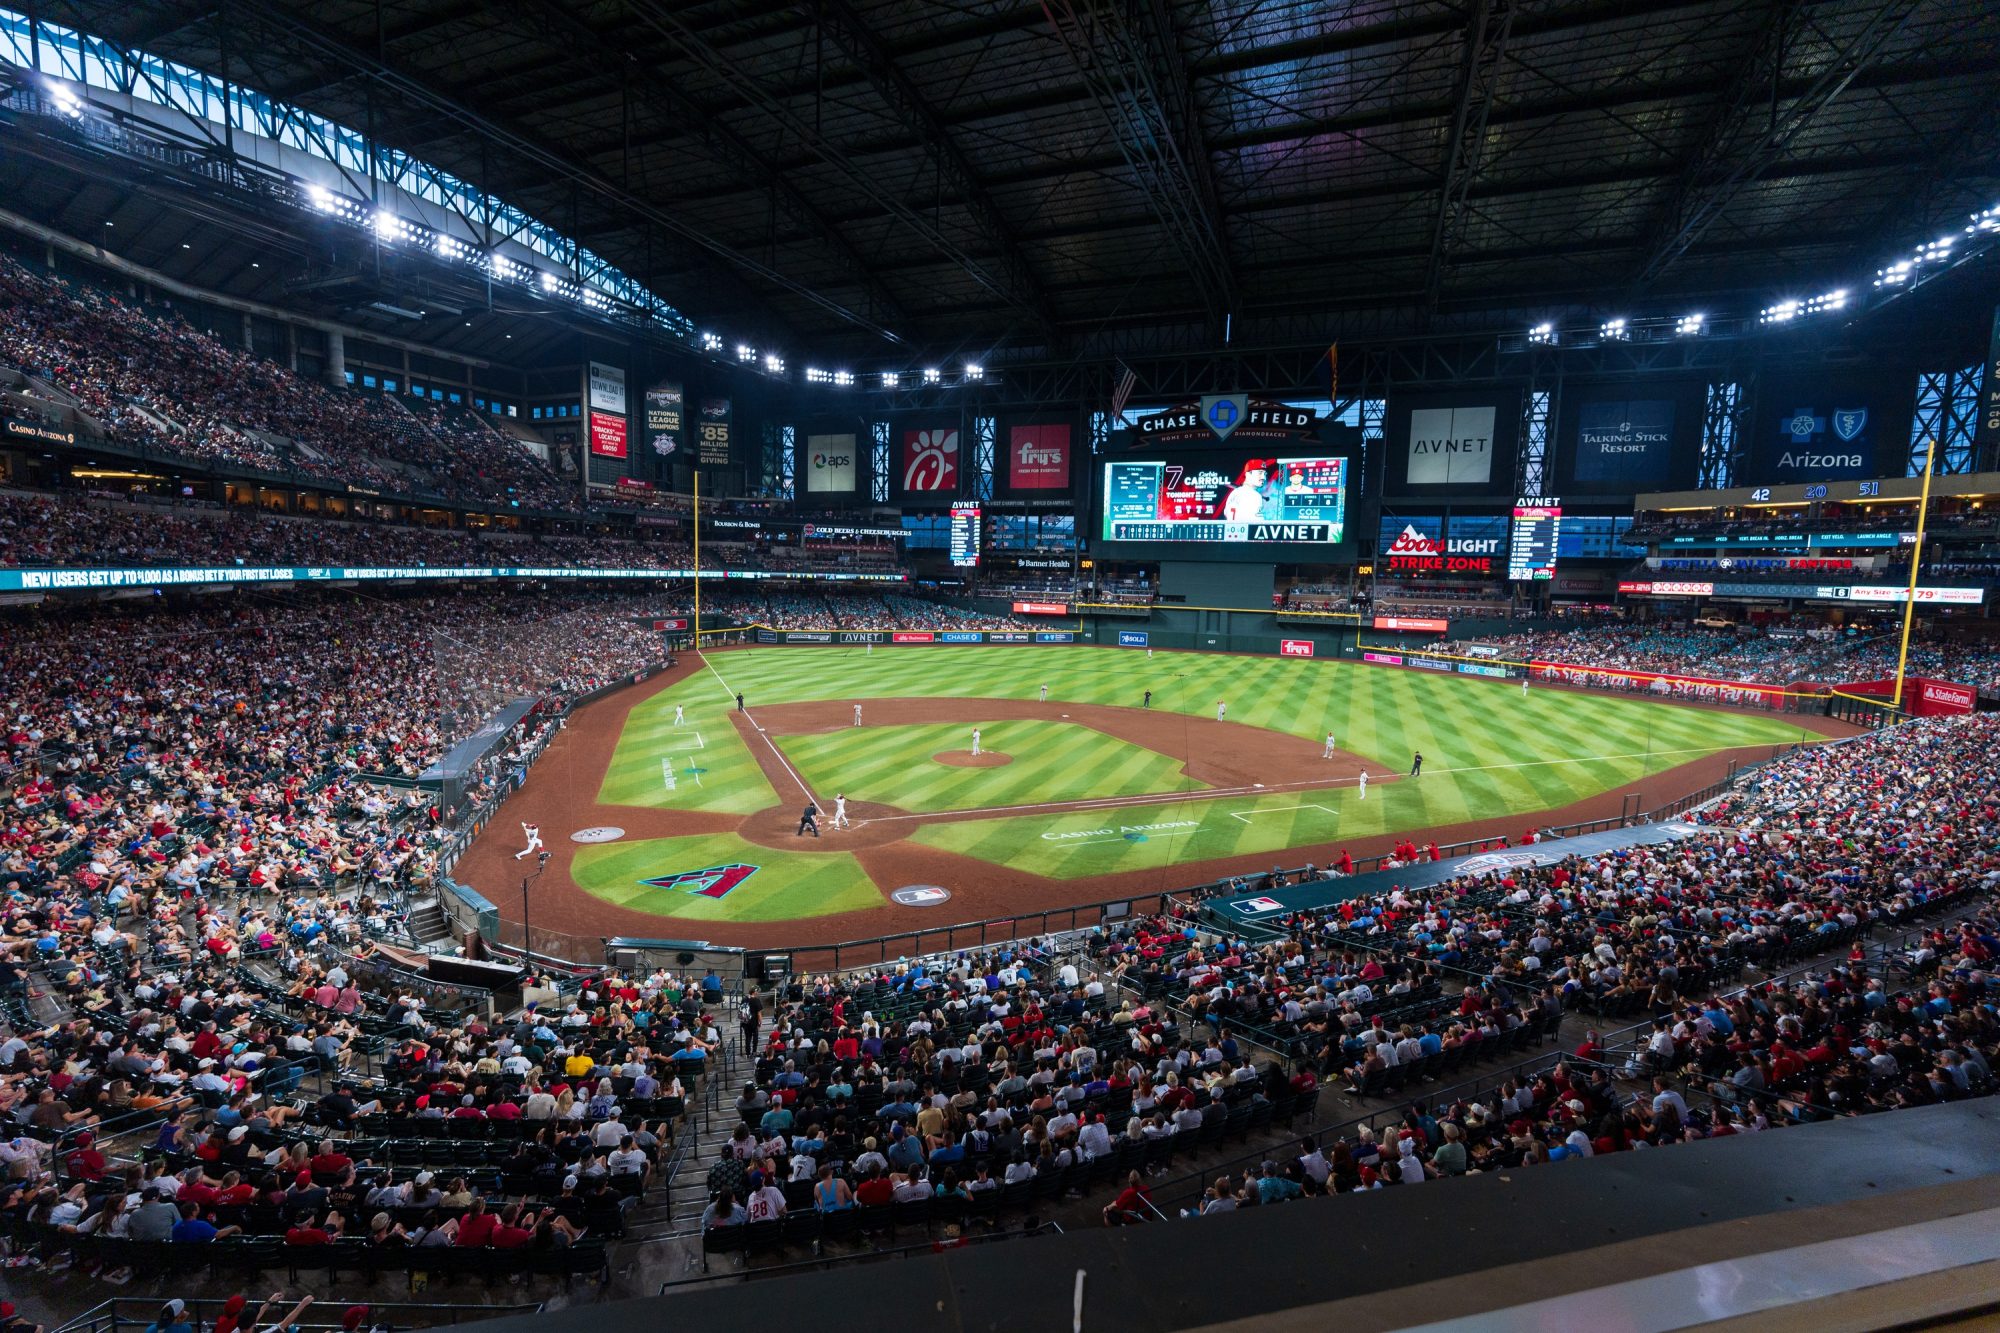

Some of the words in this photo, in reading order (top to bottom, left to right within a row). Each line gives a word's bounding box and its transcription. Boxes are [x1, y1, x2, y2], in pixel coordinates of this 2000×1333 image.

[646, 391, 681, 401] CHAMPIONS
[1143, 415, 1196, 431] CHASE
[1251, 412, 1308, 426] FIELD
[9, 422, 36, 436] CASINO
[37, 427, 67, 441] ARIZONA
[598, 434, 621, 442] LOCATION
[700, 427, 728, 441] $85
[1582, 434, 1632, 443] TALKING
[1635, 432, 1668, 442] STICK
[1414, 438, 1488, 454] AVNET
[1601, 444, 1646, 453] RESORT
[1018, 442, 1062, 465] fry's
[1777, 452, 1862, 468] Arizona
[828, 455, 850, 468] aps
[1166, 466, 1183, 490] 7
[1184, 476, 1231, 485] CARROLL
[1751, 489, 1770, 501] 42
[1804, 485, 1827, 499] 20
[1859, 482, 1879, 496] 51
[1516, 498, 1560, 506] AVNET
[1231, 508, 1236, 520] 7
[1254, 525, 1322, 539] AVNET
[1391, 532, 1446, 553] Coors
[1447, 539, 1499, 553] LIGHT
[1049, 560, 1070, 568] Health
[1390, 556, 1443, 569] STRIKE
[1446, 557, 1491, 570] ZONE
[1661, 559, 1718, 569] ESTRELLA
[1733, 559, 1786, 568] JALISCO
[1790, 559, 1853, 569] CANTINA
[22, 571, 51, 588] NEW
[52, 571, 89, 587] USERS
[89, 571, 109, 586] GET
[109, 571, 123, 585] UP
[125, 570, 137, 584] TO
[137, 570, 161, 584] $1,000
[162, 570, 173, 583] AS
[173, 570, 179, 583] A
[180, 570, 204, 582] BONUS
[205, 570, 218, 581] BET
[218, 570, 224, 581] IF
[224, 569, 242, 581] YOUR
[242, 569, 258, 580] FIRST
[259, 569, 270, 580] BET
[271, 569, 293, 580] LOSES
[1838, 589, 1845, 597] 6
[845, 633, 878, 641] AVNET
[1285, 641, 1310, 654] fry's
[1433, 661, 1448, 669] Health
[1483, 668, 1499, 676] COX
[1675, 679, 1716, 695] State
[1719, 683, 1762, 702] Farm
[1041, 829, 1113, 840] CASINO
[1121, 820, 1200, 833] ARIZONA
[593, 1104, 607, 1114] 20
[796, 1165, 802, 1177] 7
[753, 1201, 768, 1218] 28
